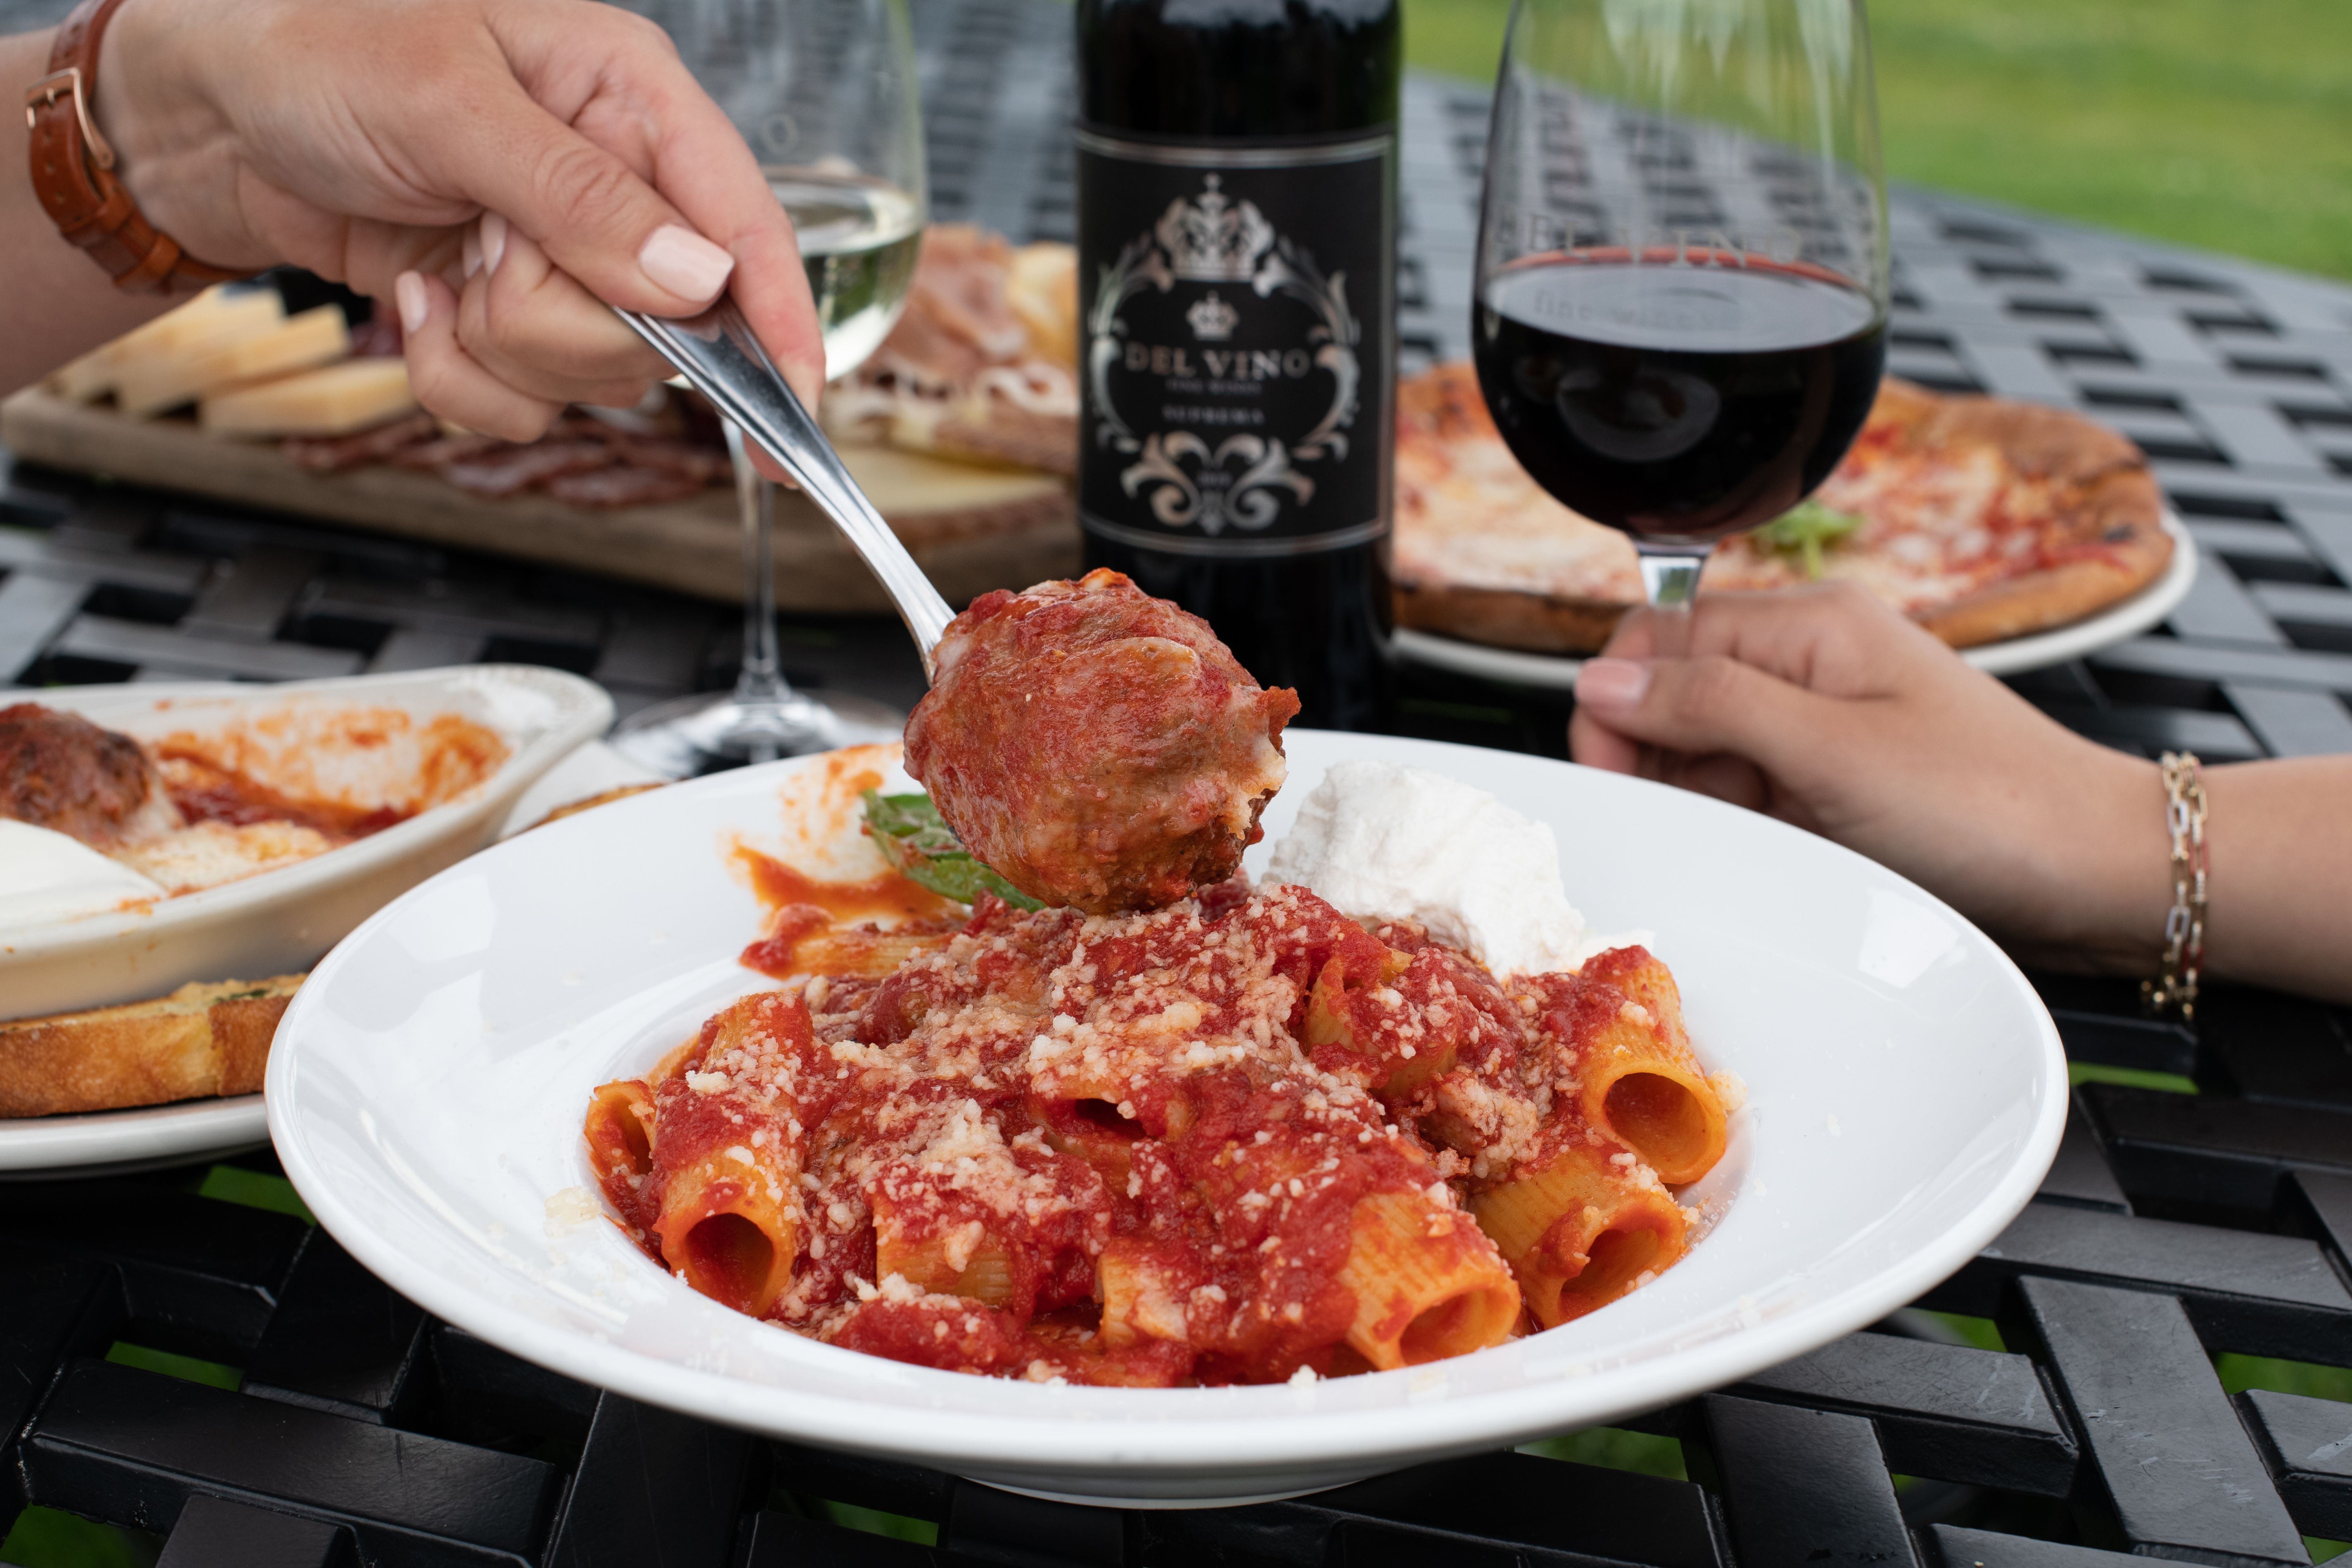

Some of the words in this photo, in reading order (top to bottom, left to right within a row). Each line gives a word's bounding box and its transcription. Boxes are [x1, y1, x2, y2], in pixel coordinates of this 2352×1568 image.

[1615, 225, 1801, 269] VINO
[1125, 342, 1196, 377] DEL
[1202, 349, 1311, 381] VINO
